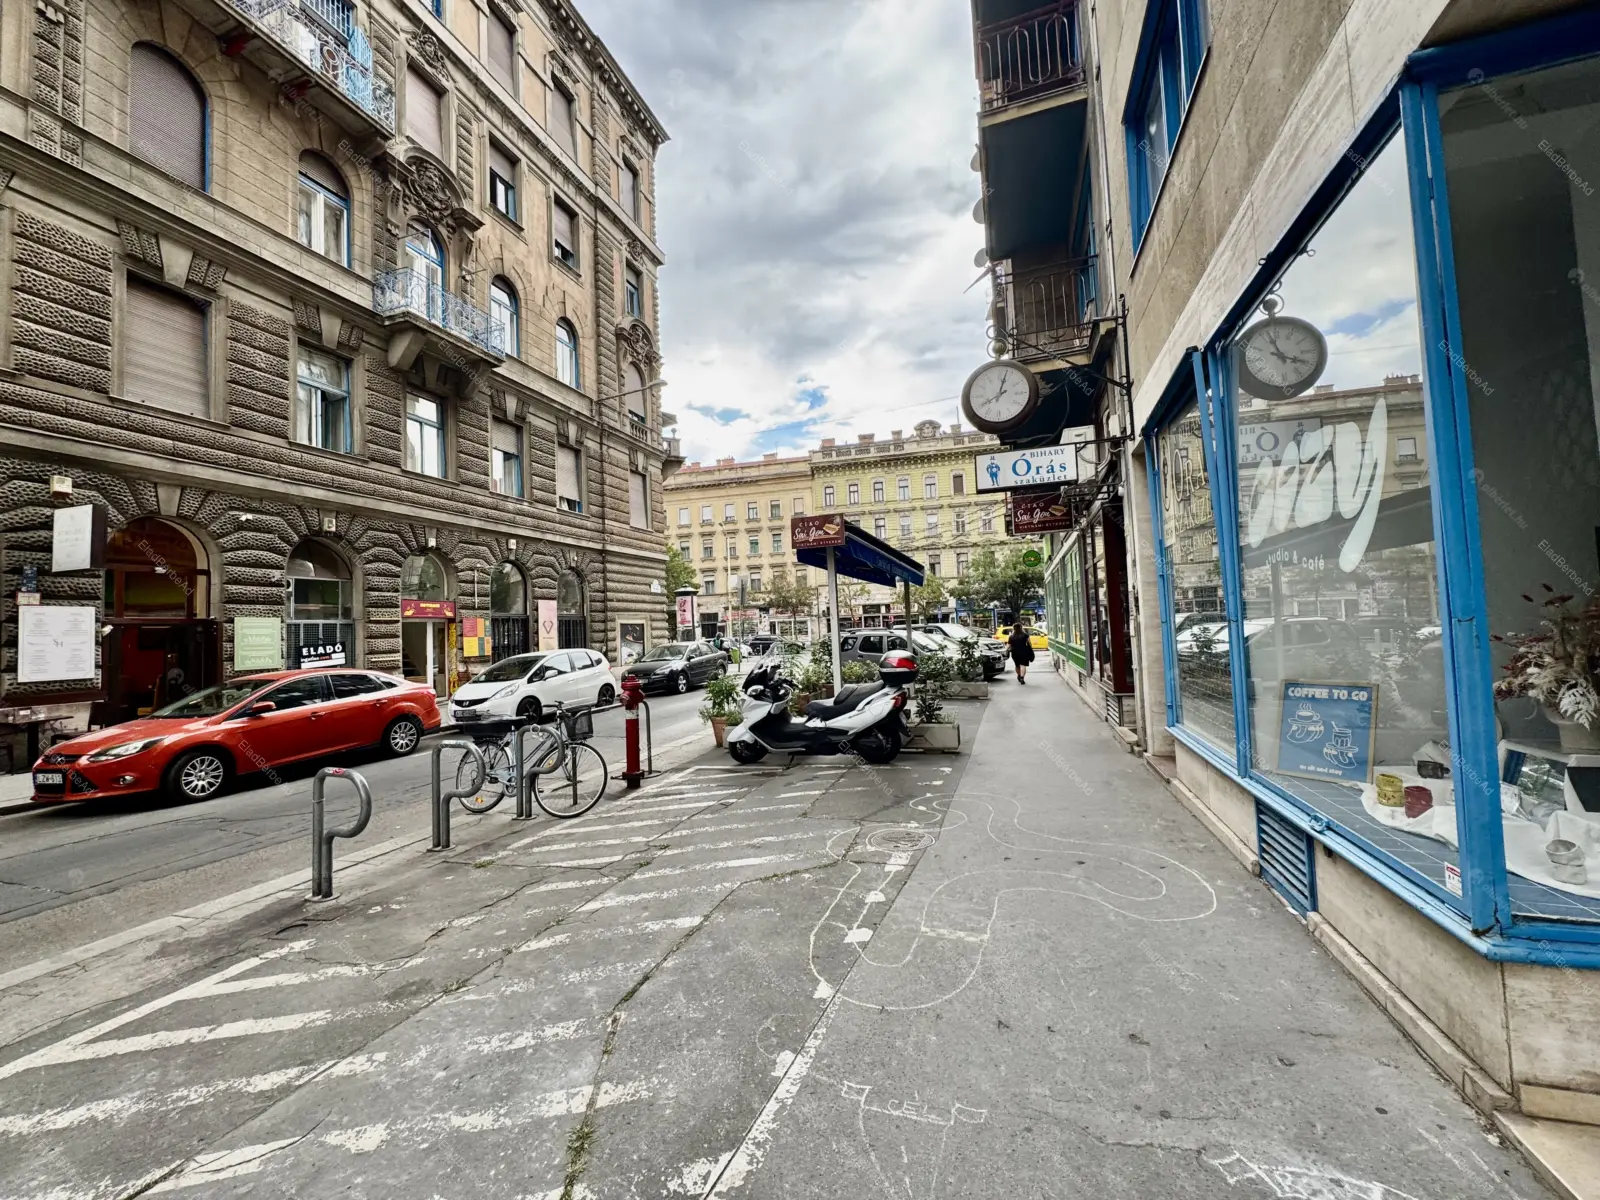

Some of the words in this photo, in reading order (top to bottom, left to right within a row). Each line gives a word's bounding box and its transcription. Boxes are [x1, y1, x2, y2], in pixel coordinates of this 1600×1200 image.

[1029, 448, 1065, 459] BIHARY
[1011, 453, 1067, 477] Órás
[1014, 473, 1068, 485] szaküzlet
[1015, 509, 1031, 522] Sai
[1033, 508, 1051, 524] Gon
[798, 520, 819, 528] CIAO
[793, 527, 808, 541] Sai
[808, 526, 825, 541] Gon
[1265, 547, 1289, 567] studio
[1292, 549, 1299, 565] &
[1302, 553, 1325, 571] café
[302, 642, 343, 657] ELADÓ
[1288, 687, 1329, 699] COFFEE
[1332, 689, 1348, 701] TO
[1351, 691, 1368, 702] GO
